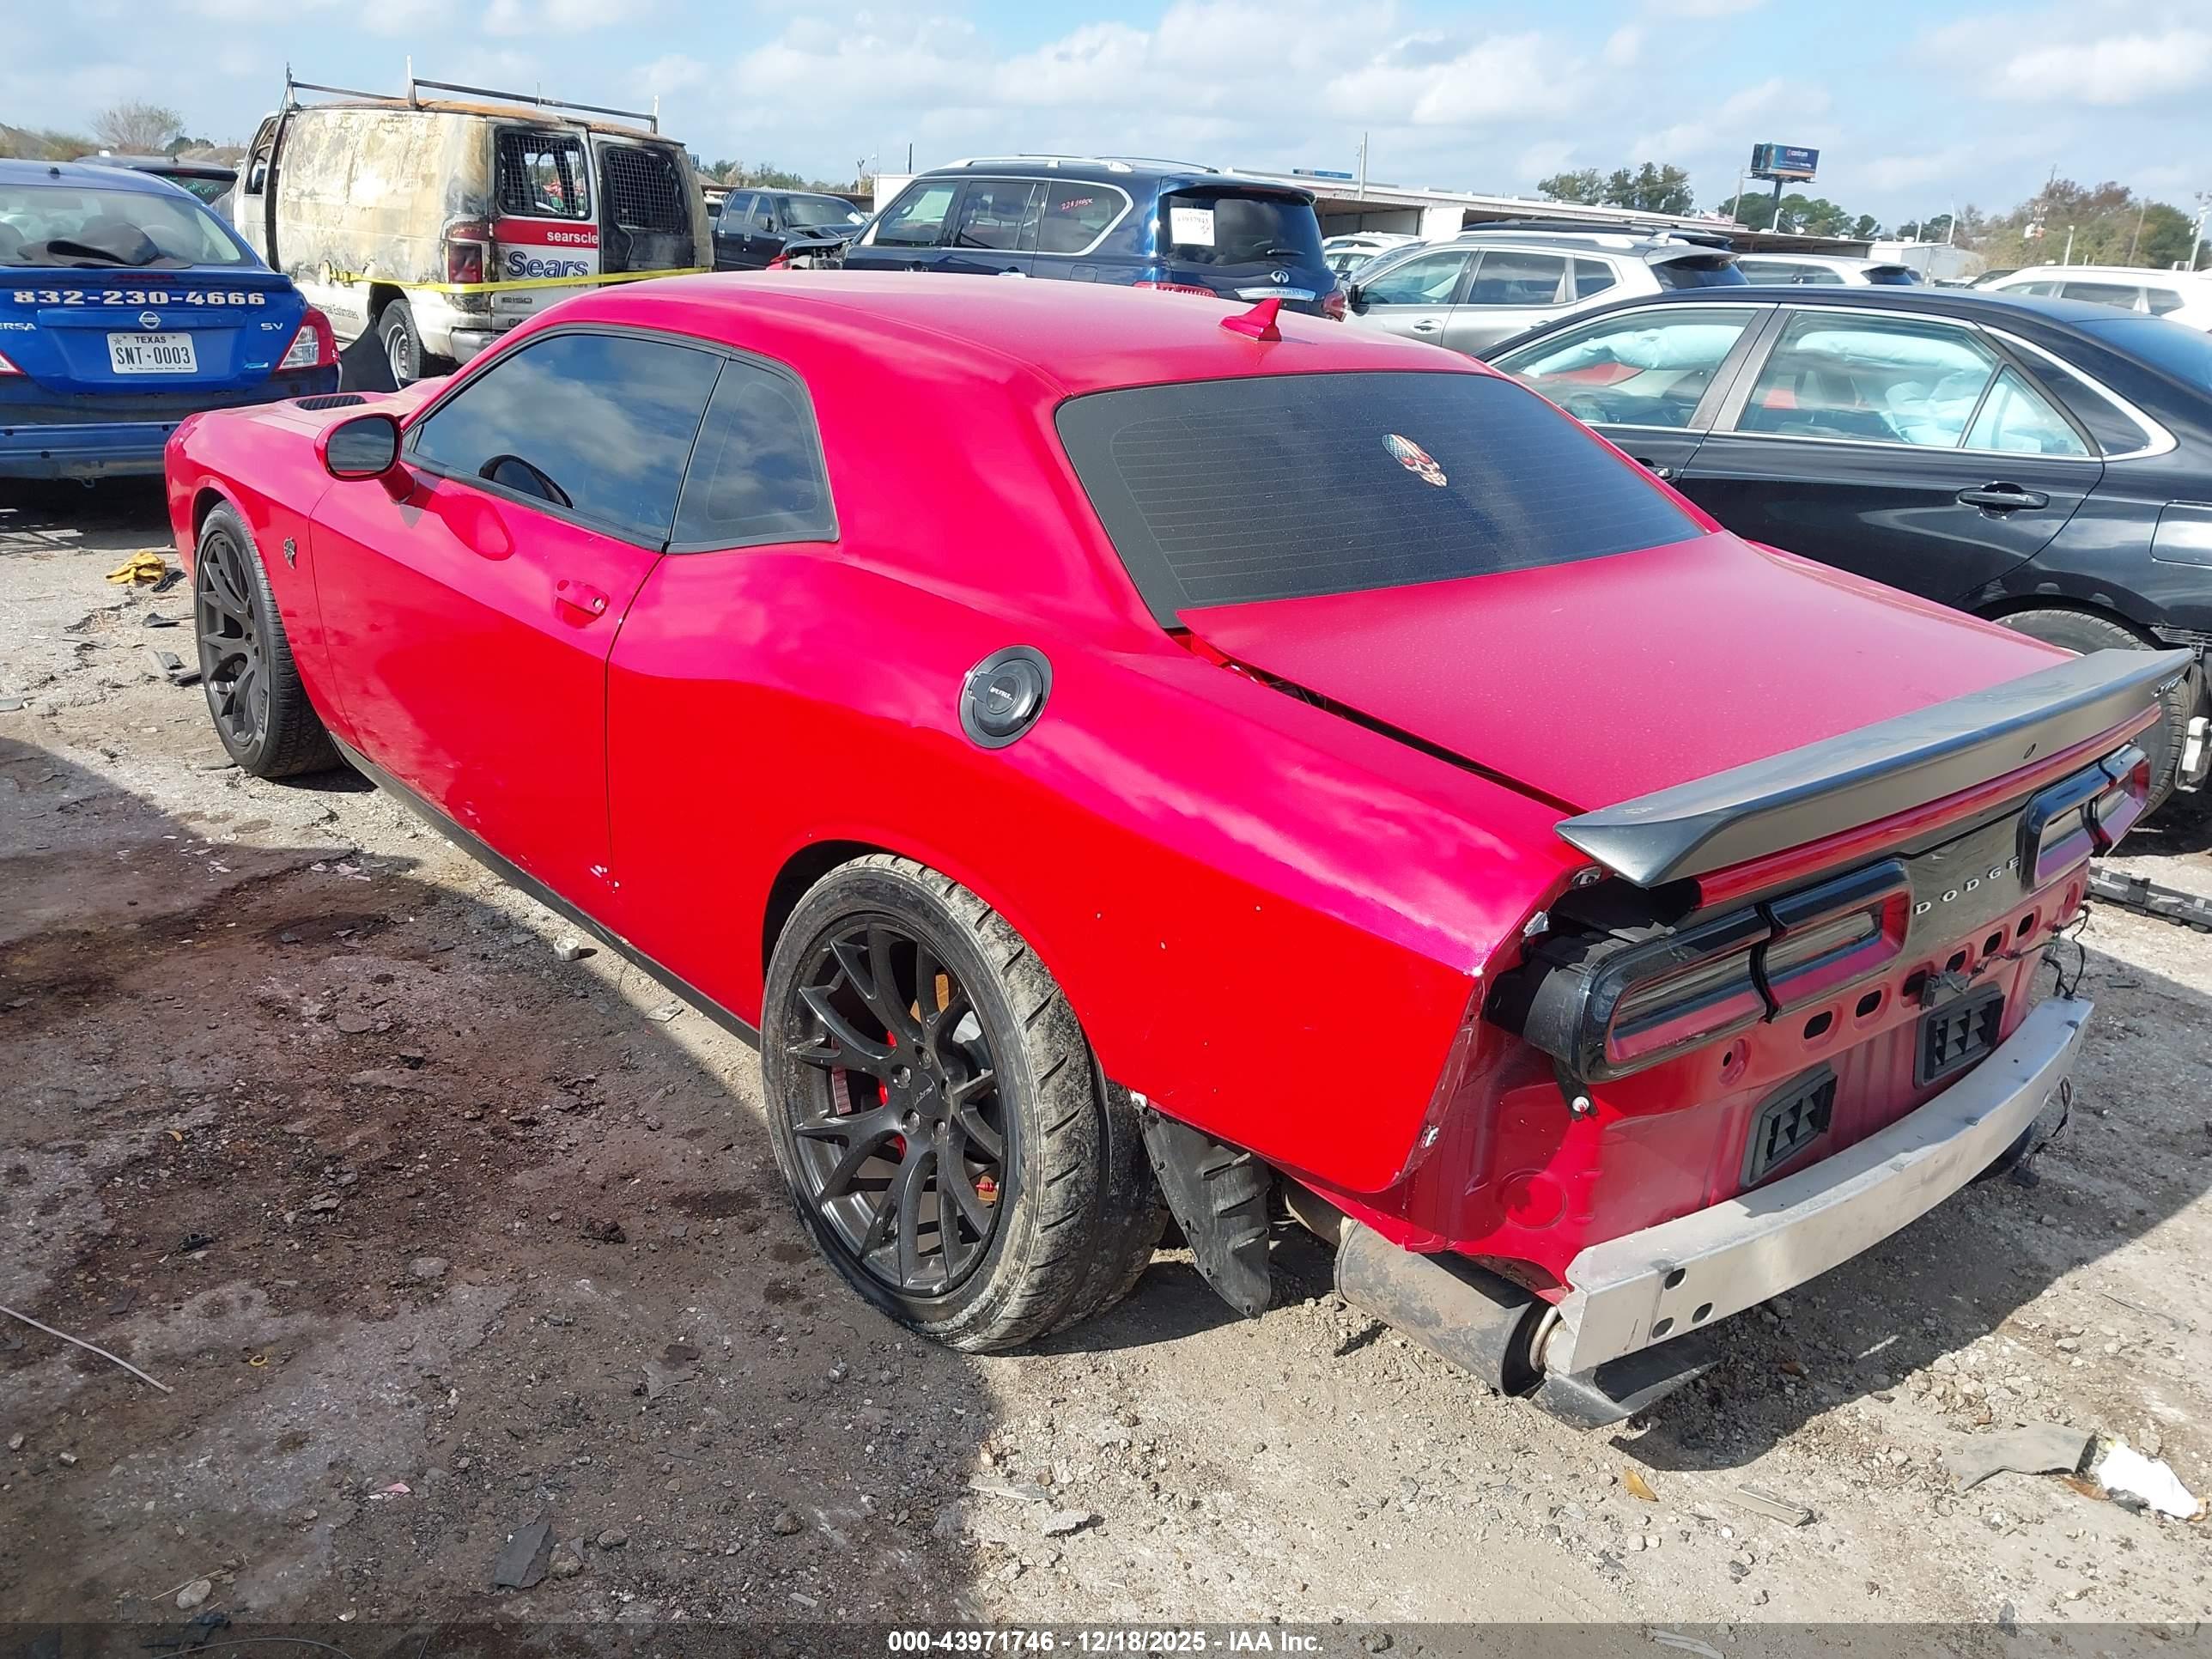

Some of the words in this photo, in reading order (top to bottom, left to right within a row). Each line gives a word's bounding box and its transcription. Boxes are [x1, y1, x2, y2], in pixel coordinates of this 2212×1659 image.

[507, 251, 589, 278] Sears
[13, 290, 265, 305] 832-230-4666
[260, 322, 283, 331] SV
[115, 346, 143, 365] SNT
[153, 346, 191, 364] 0003
[1914, 855, 2021, 916] DODGE
